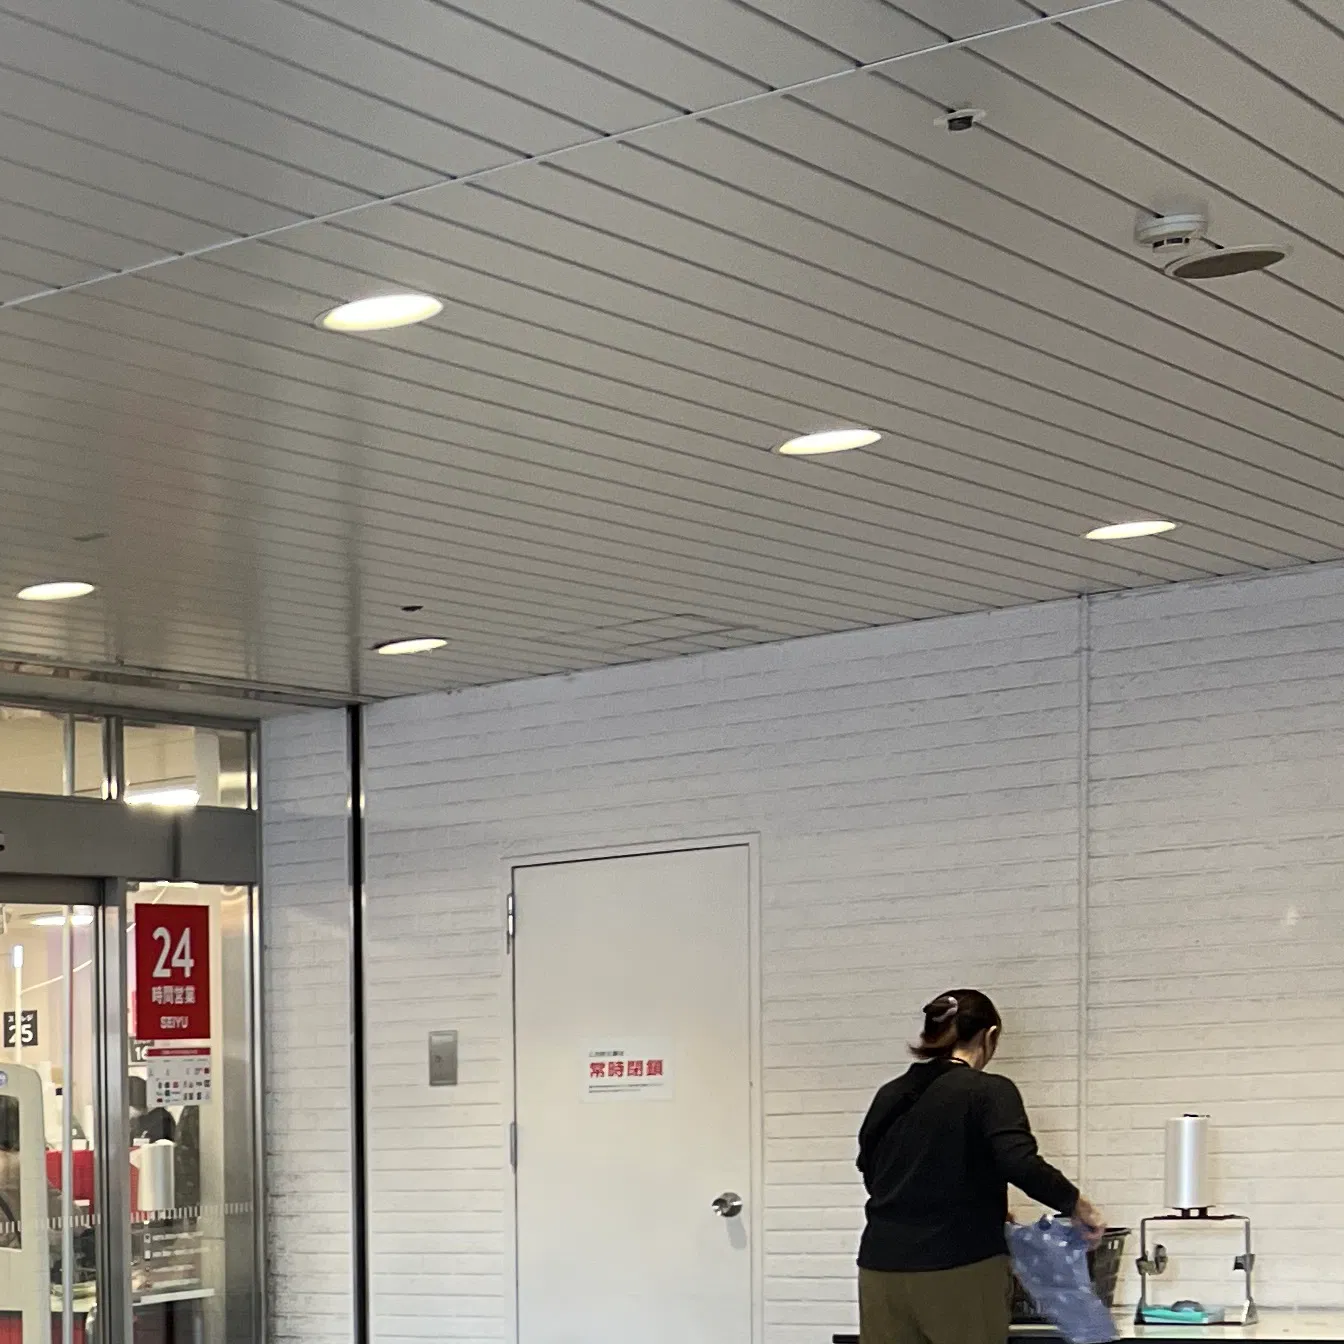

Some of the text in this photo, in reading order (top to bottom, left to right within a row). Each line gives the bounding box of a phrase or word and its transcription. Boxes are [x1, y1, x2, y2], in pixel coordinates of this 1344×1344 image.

[152, 926, 195, 978] 24
[151, 985, 197, 1005] 時間営業
[160, 1016, 189, 1029] SEIYU
